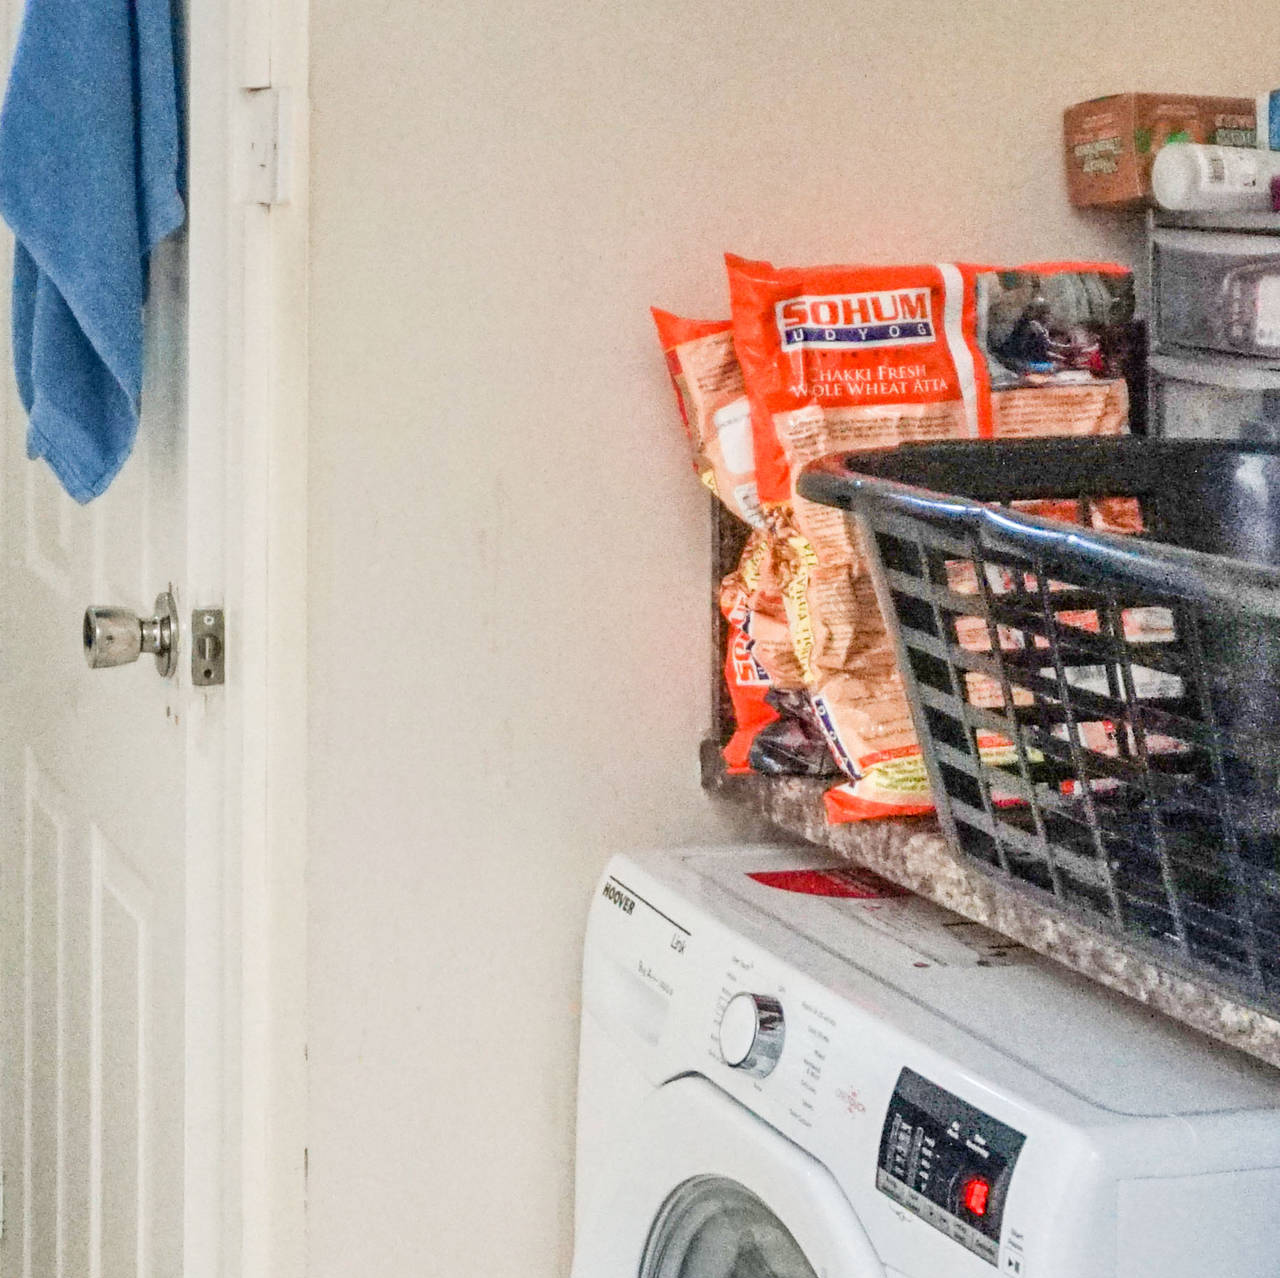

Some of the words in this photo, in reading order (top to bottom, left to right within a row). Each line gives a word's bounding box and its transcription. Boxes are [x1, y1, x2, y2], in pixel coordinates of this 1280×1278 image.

[782, 293, 929, 327] SOHUM
[793, 323, 927, 342] UDYOG
[811, 367, 872, 382] HAKKI
[877, 364, 926, 381] FRESH
[788, 382, 843, 398] WOLE
[846, 380, 909, 397] WHEAT
[913, 376, 949, 393] ATTA
[602, 883, 635, 915] HOOVER
